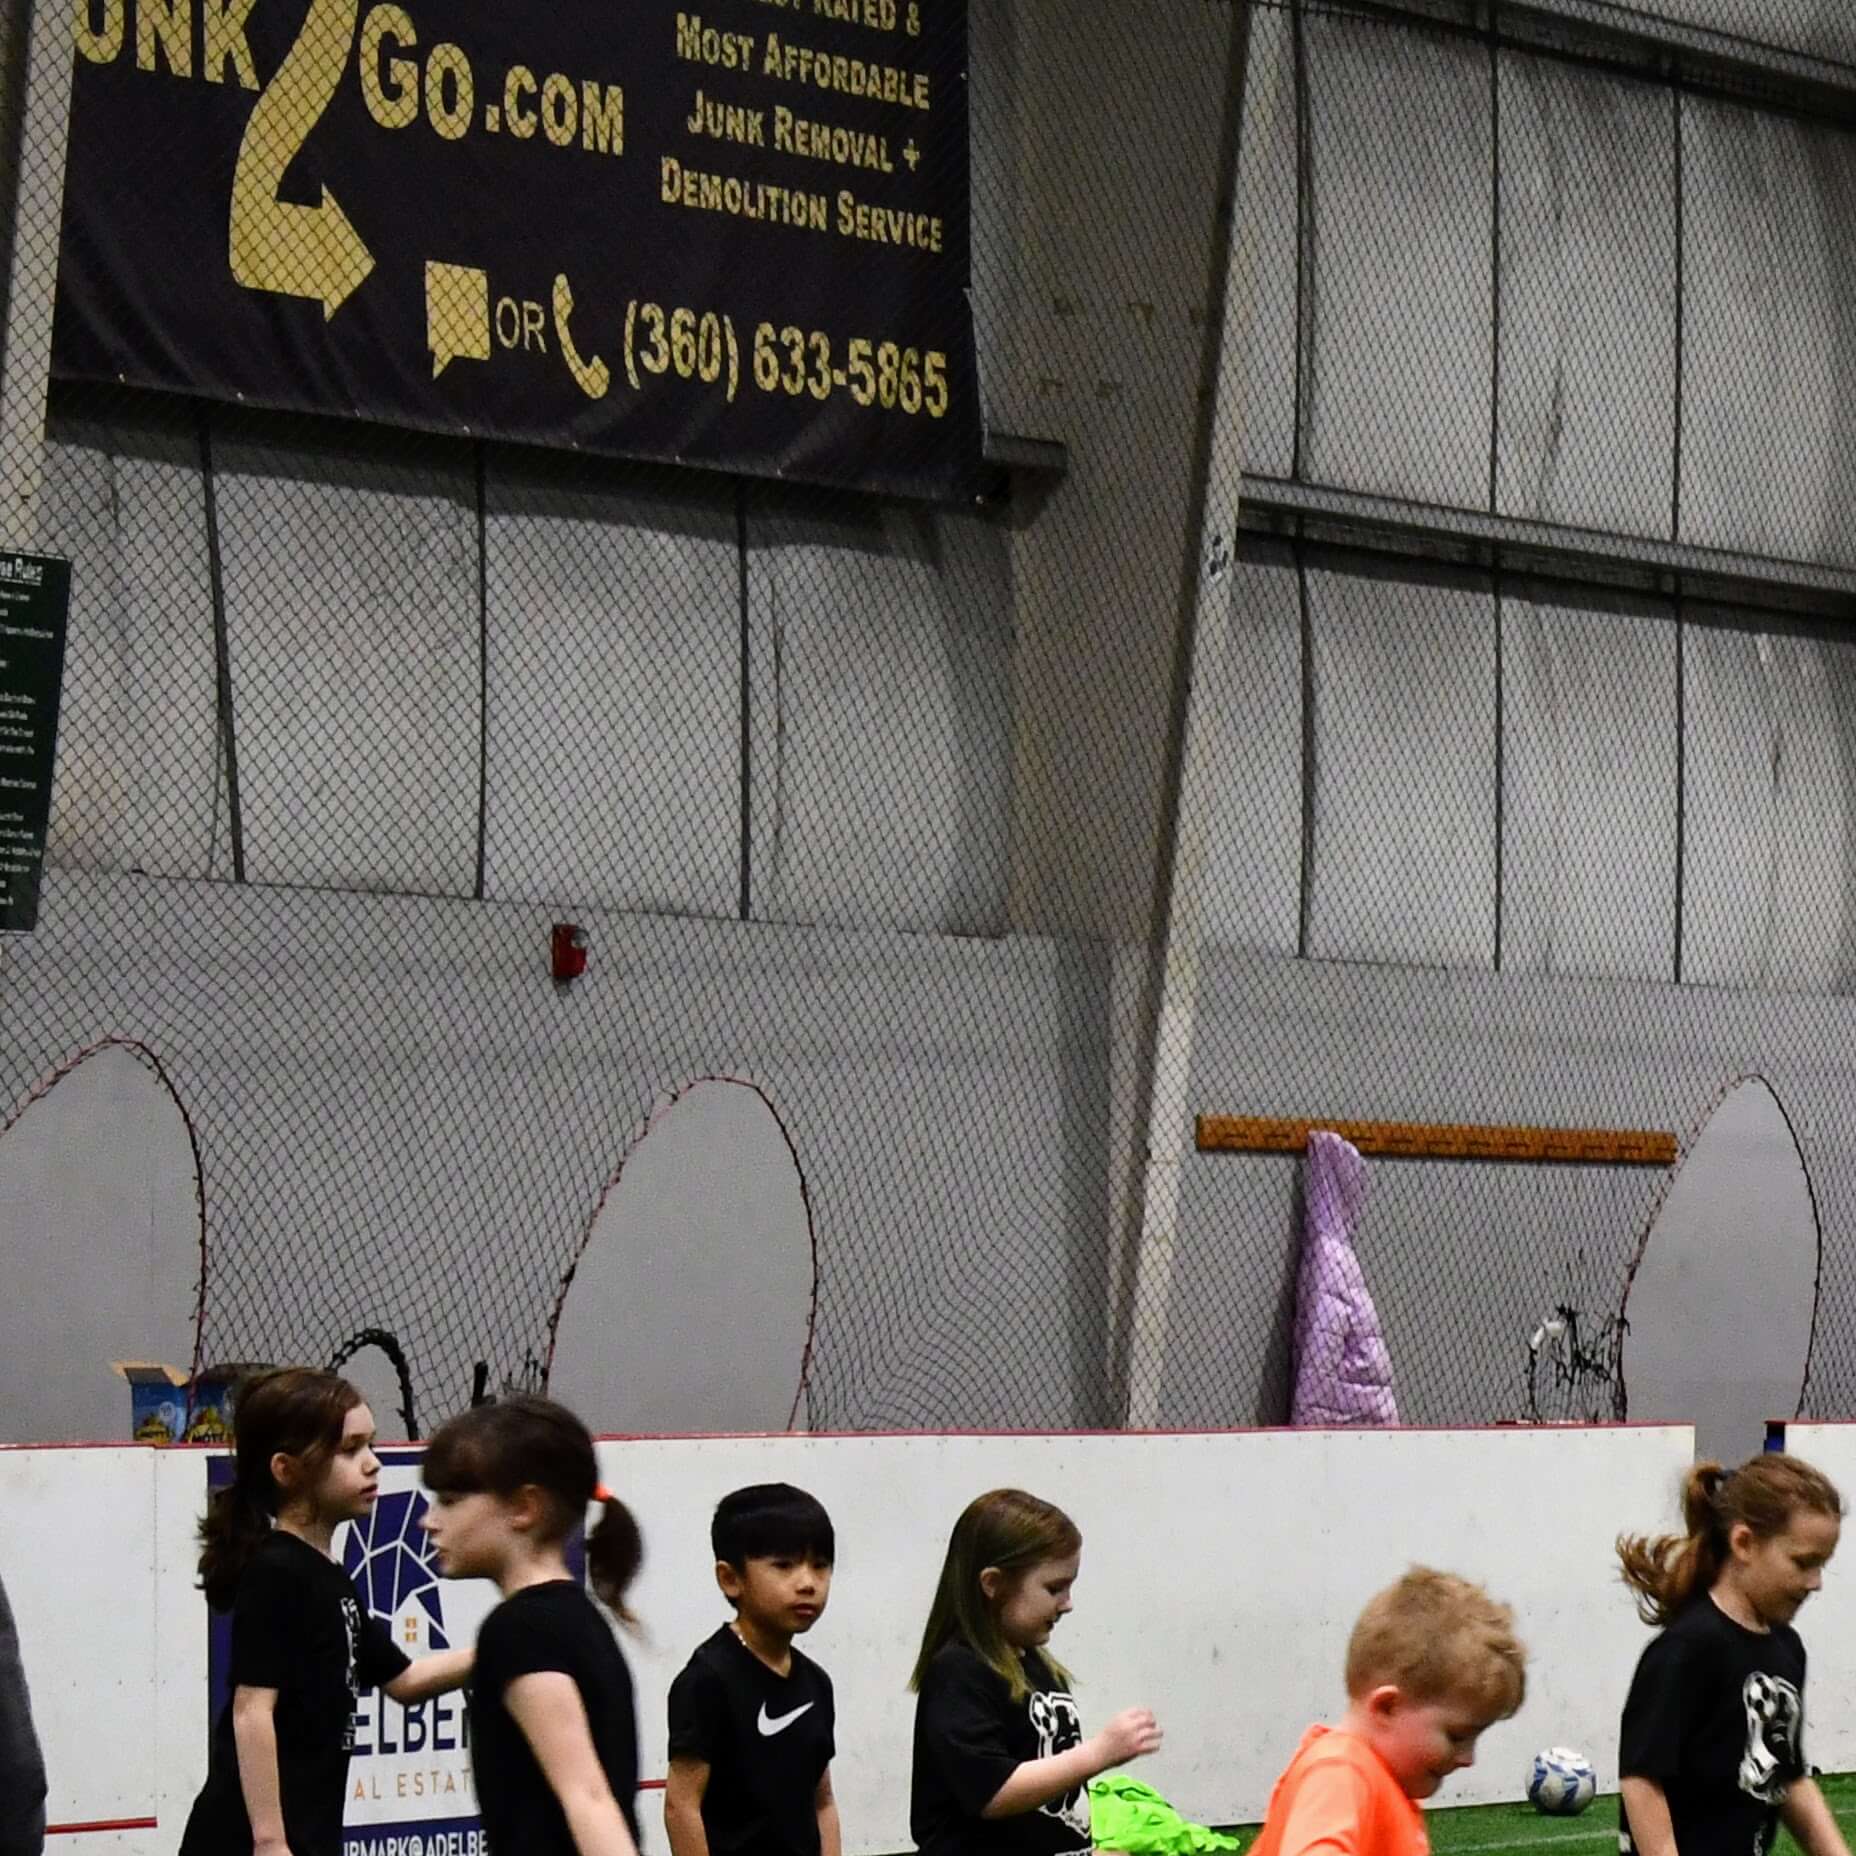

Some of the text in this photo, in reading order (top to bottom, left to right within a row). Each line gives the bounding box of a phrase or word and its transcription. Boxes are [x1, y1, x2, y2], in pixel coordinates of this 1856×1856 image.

[73, 0, 260, 92] UNK
[676, 12, 930, 110] MOST AFFORDABLE
[687, 89, 765, 147] JUNK
[774, 105, 894, 173] REMOVAL
[660, 155, 944, 253] DEMOLITION SERVICE
[495, 296, 949, 418] OR (360) 633-5865
[397, 1768, 471, 1798] ESTAT
